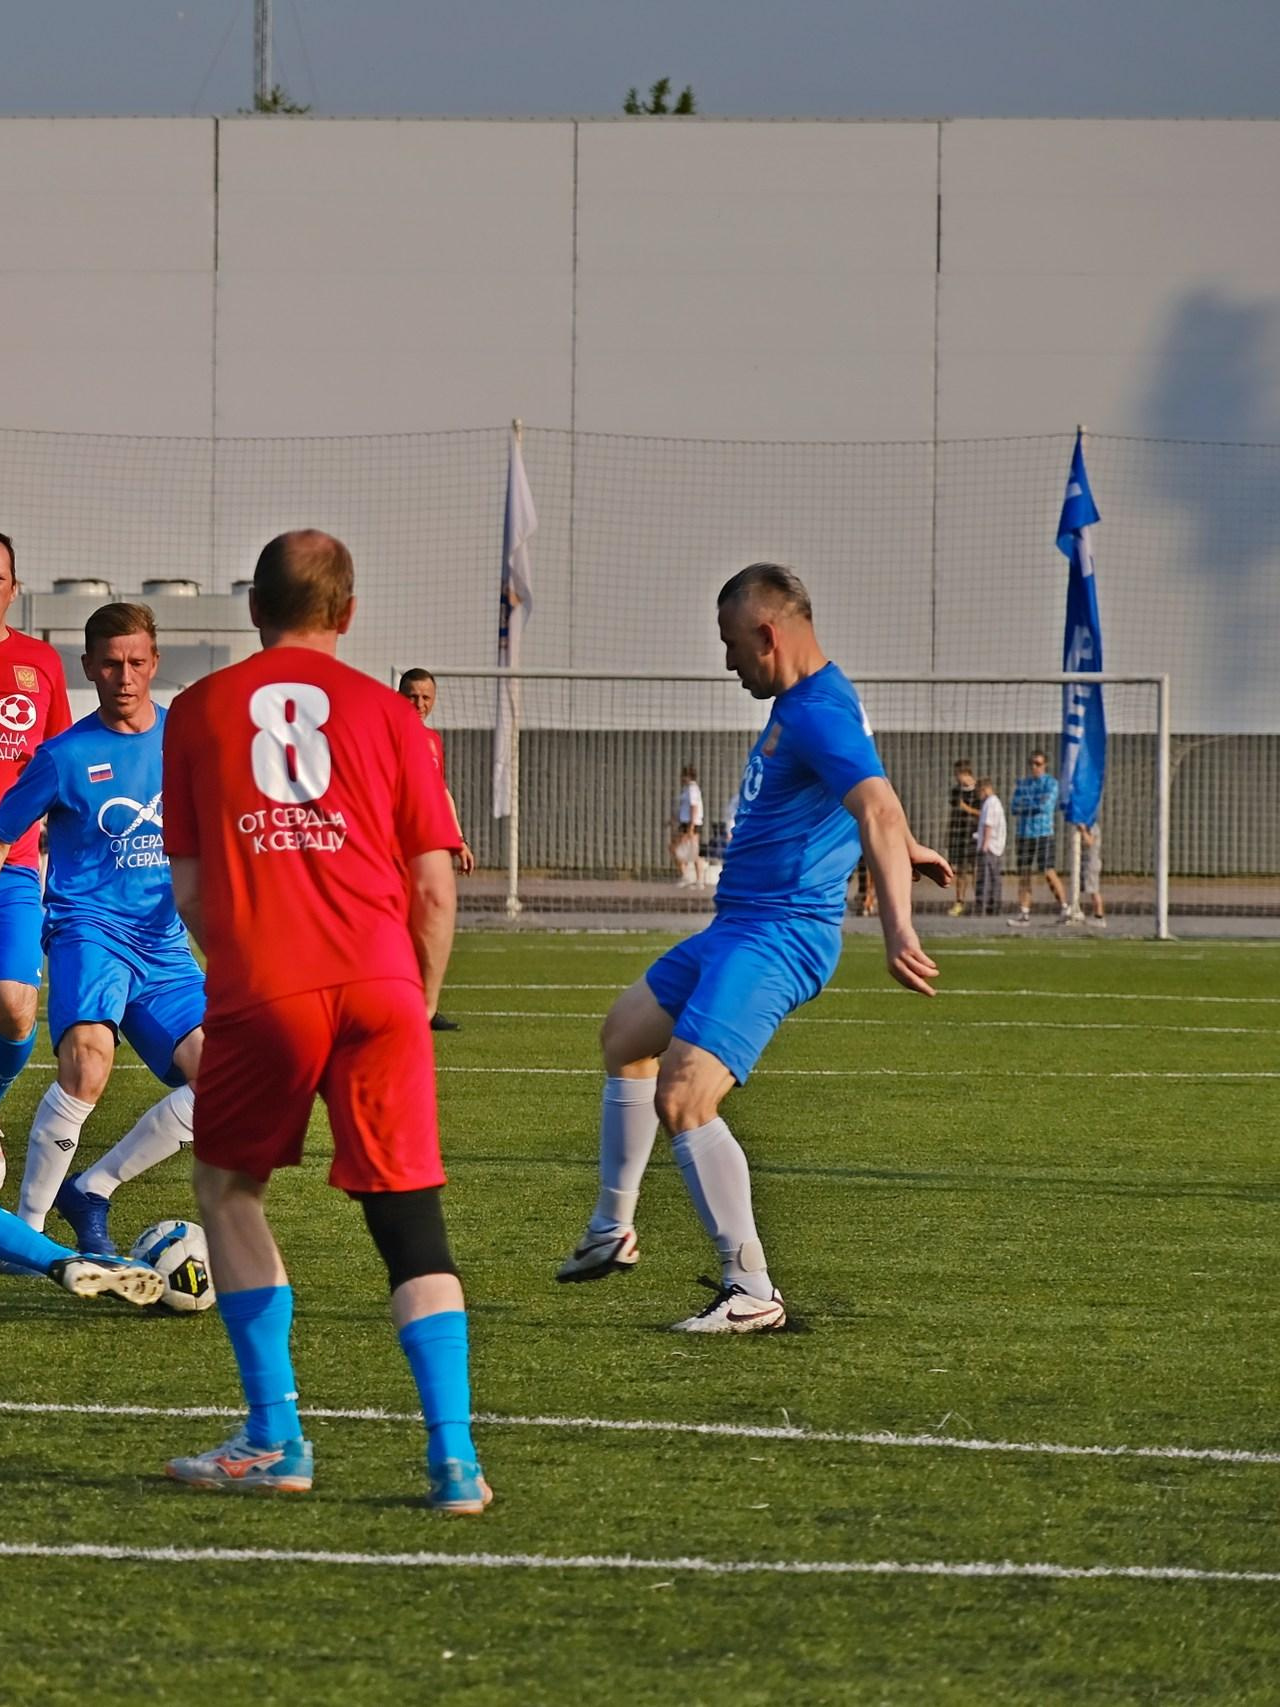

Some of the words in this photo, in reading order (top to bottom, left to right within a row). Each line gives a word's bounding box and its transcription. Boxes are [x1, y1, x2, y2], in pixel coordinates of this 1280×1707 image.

[249, 682, 331, 804] 8
[238, 811, 267, 833] ОТ
[271, 808, 347, 829] СЕРДЦА
[110, 838, 129, 853] ОТ
[132, 834, 164, 849] СЕРД
[254, 834, 268, 854] К
[270, 831, 347, 853] СЕРДЦУ
[115, 856, 124, 870] К
[127, 850, 170, 868] СЕРДЦ
